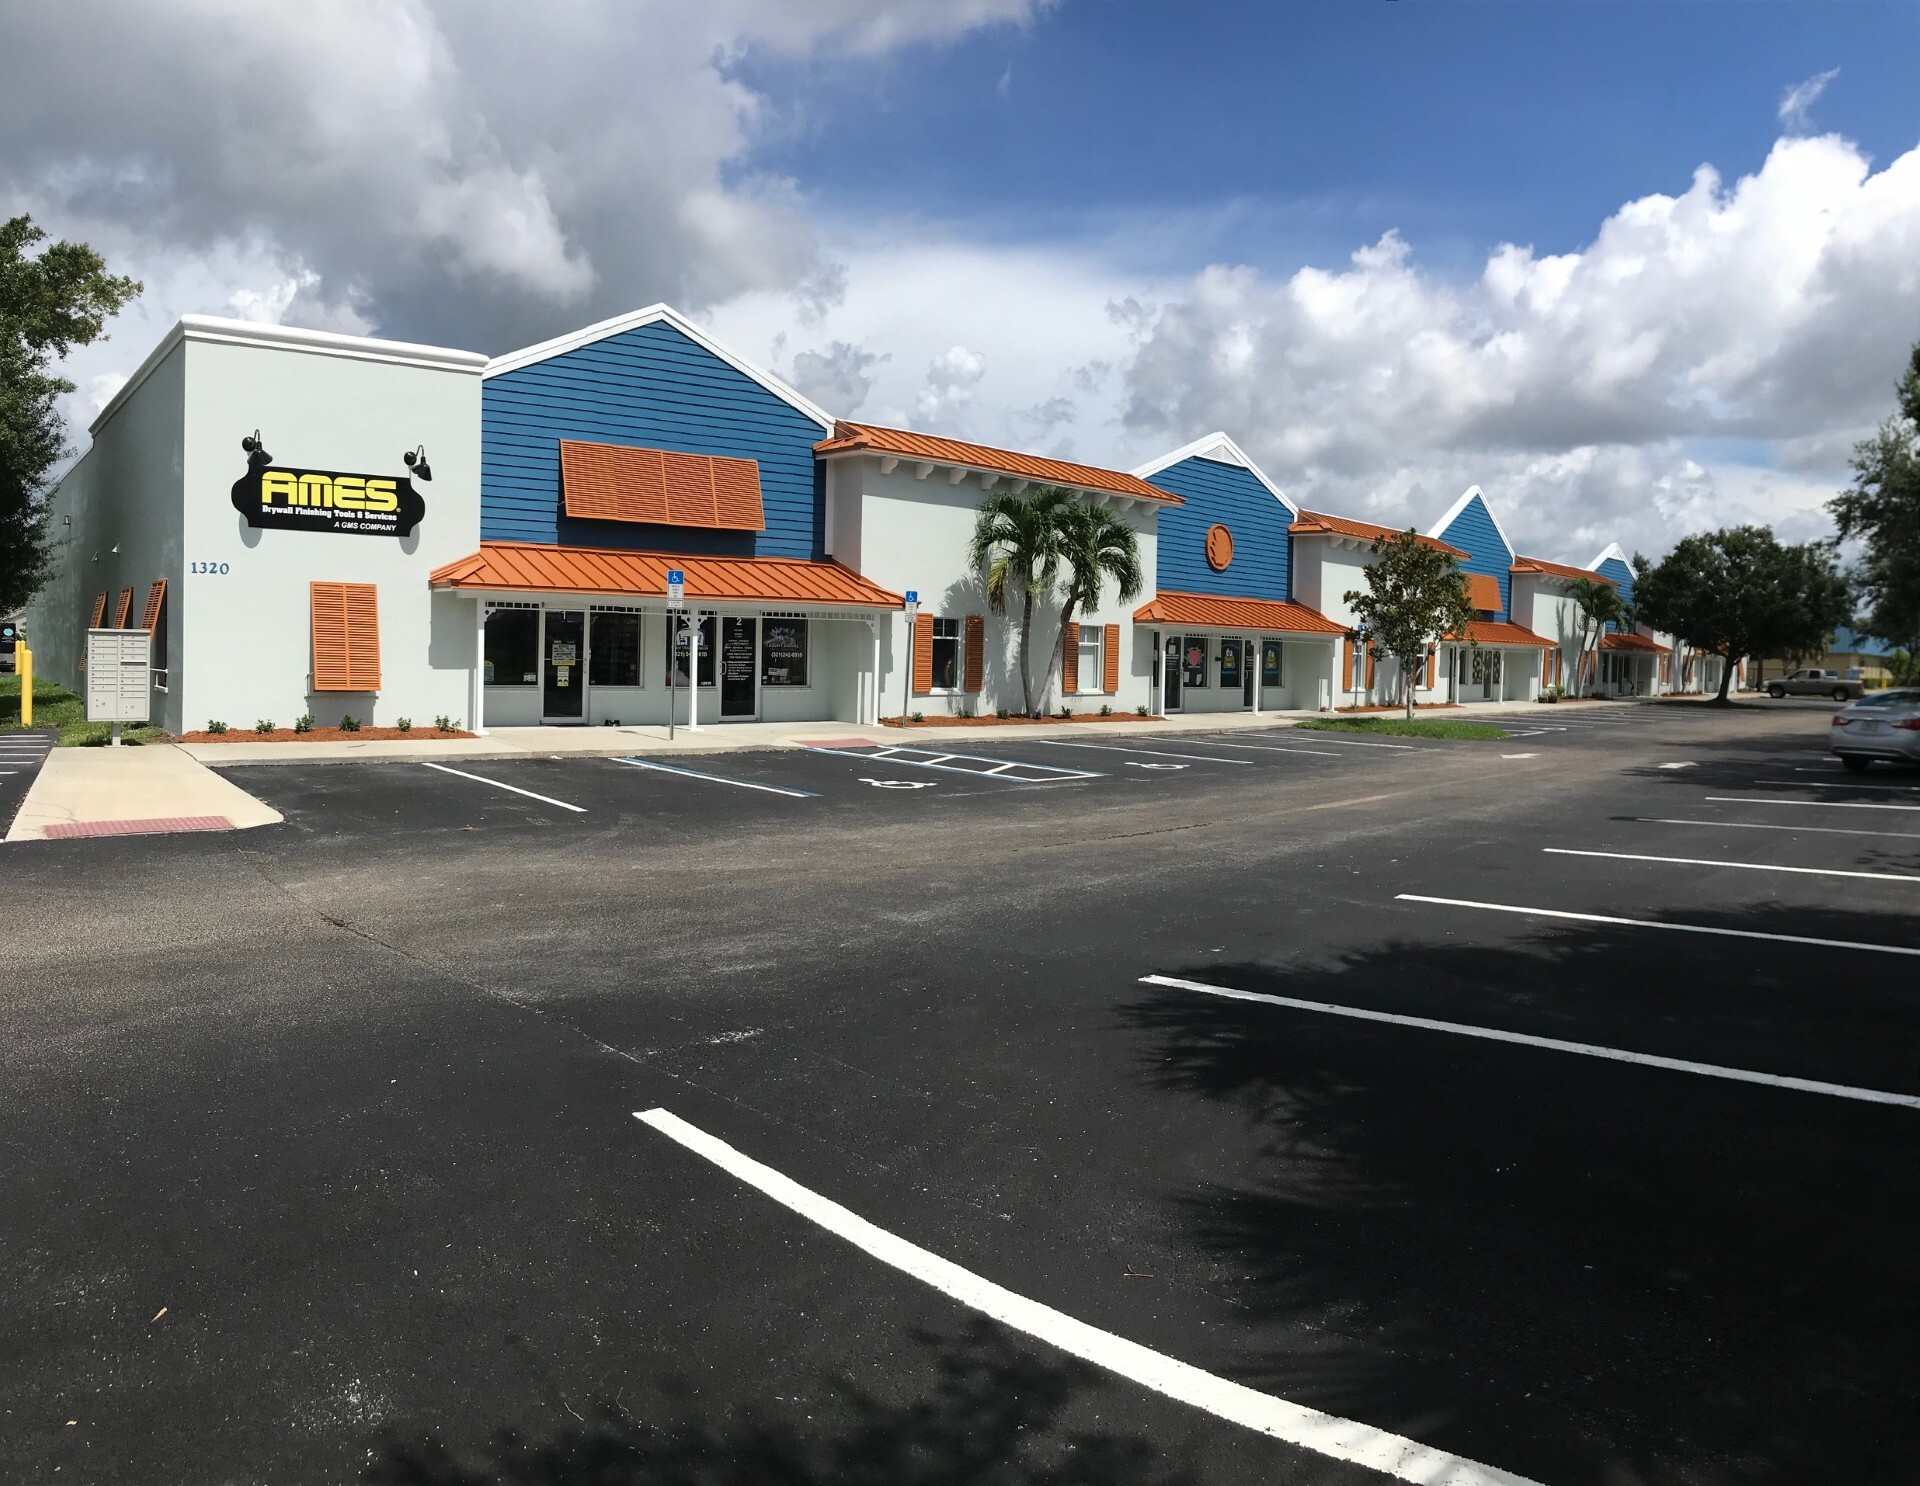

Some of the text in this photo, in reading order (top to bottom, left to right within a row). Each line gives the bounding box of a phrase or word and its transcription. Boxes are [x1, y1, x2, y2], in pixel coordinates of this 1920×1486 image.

[261, 471, 398, 512] AMES
[261, 505, 397, 521] Drywall Finishing Tools & Services
[341, 522, 359, 530] GMS
[360, 523, 397, 531] COMPANY
[191, 561, 230, 575] 1320
[736, 617, 742, 626] 2
